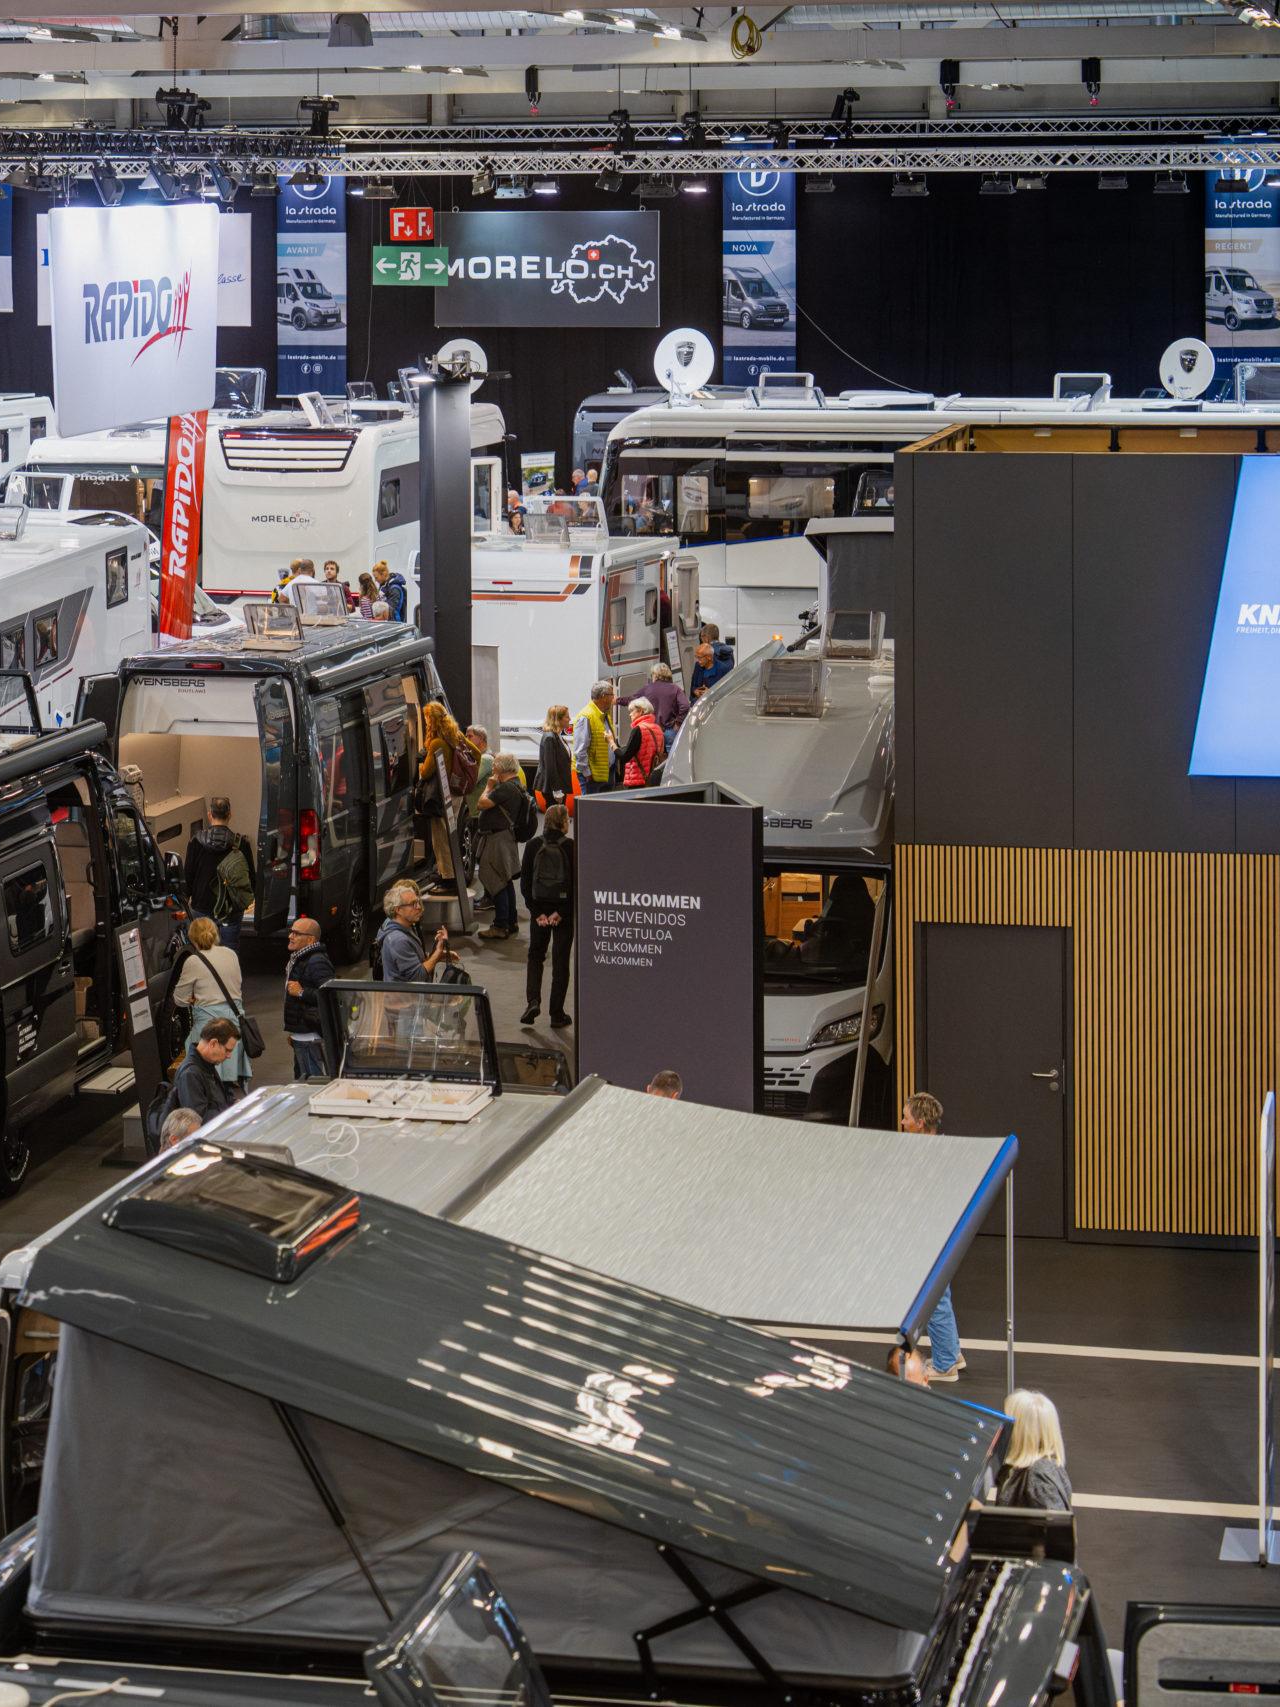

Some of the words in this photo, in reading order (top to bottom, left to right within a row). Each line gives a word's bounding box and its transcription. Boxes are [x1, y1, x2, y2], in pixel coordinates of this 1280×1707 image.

[285, 206, 296, 215] la
[298, 206, 337, 215] strada
[732, 203, 743, 212] la
[745, 203, 786, 212] strada
[1215, 200, 1227, 209] la
[1229, 200, 1272, 209] strada
[393, 212, 405, 237] F
[418, 212, 427, 237] F
[286, 246, 318, 254] AVANTI
[732, 244, 758, 252] NOVA
[447, 254, 634, 280] MORELO.CH
[217, 272, 247, 286] lasse
[1237, 603, 1280, 625] KN
[133, 677, 206, 688] WEINSBERG
[763, 818, 813, 829] SBERG
[593, 890, 701, 910] WILLKOMMEN
[594, 909, 686, 927] BIENVENIDOS
[593, 925, 673, 941] TERVETULOA
[593, 941, 662, 955] VELKOMMEN
[593, 954, 653, 968] VÄLKOMMEN
